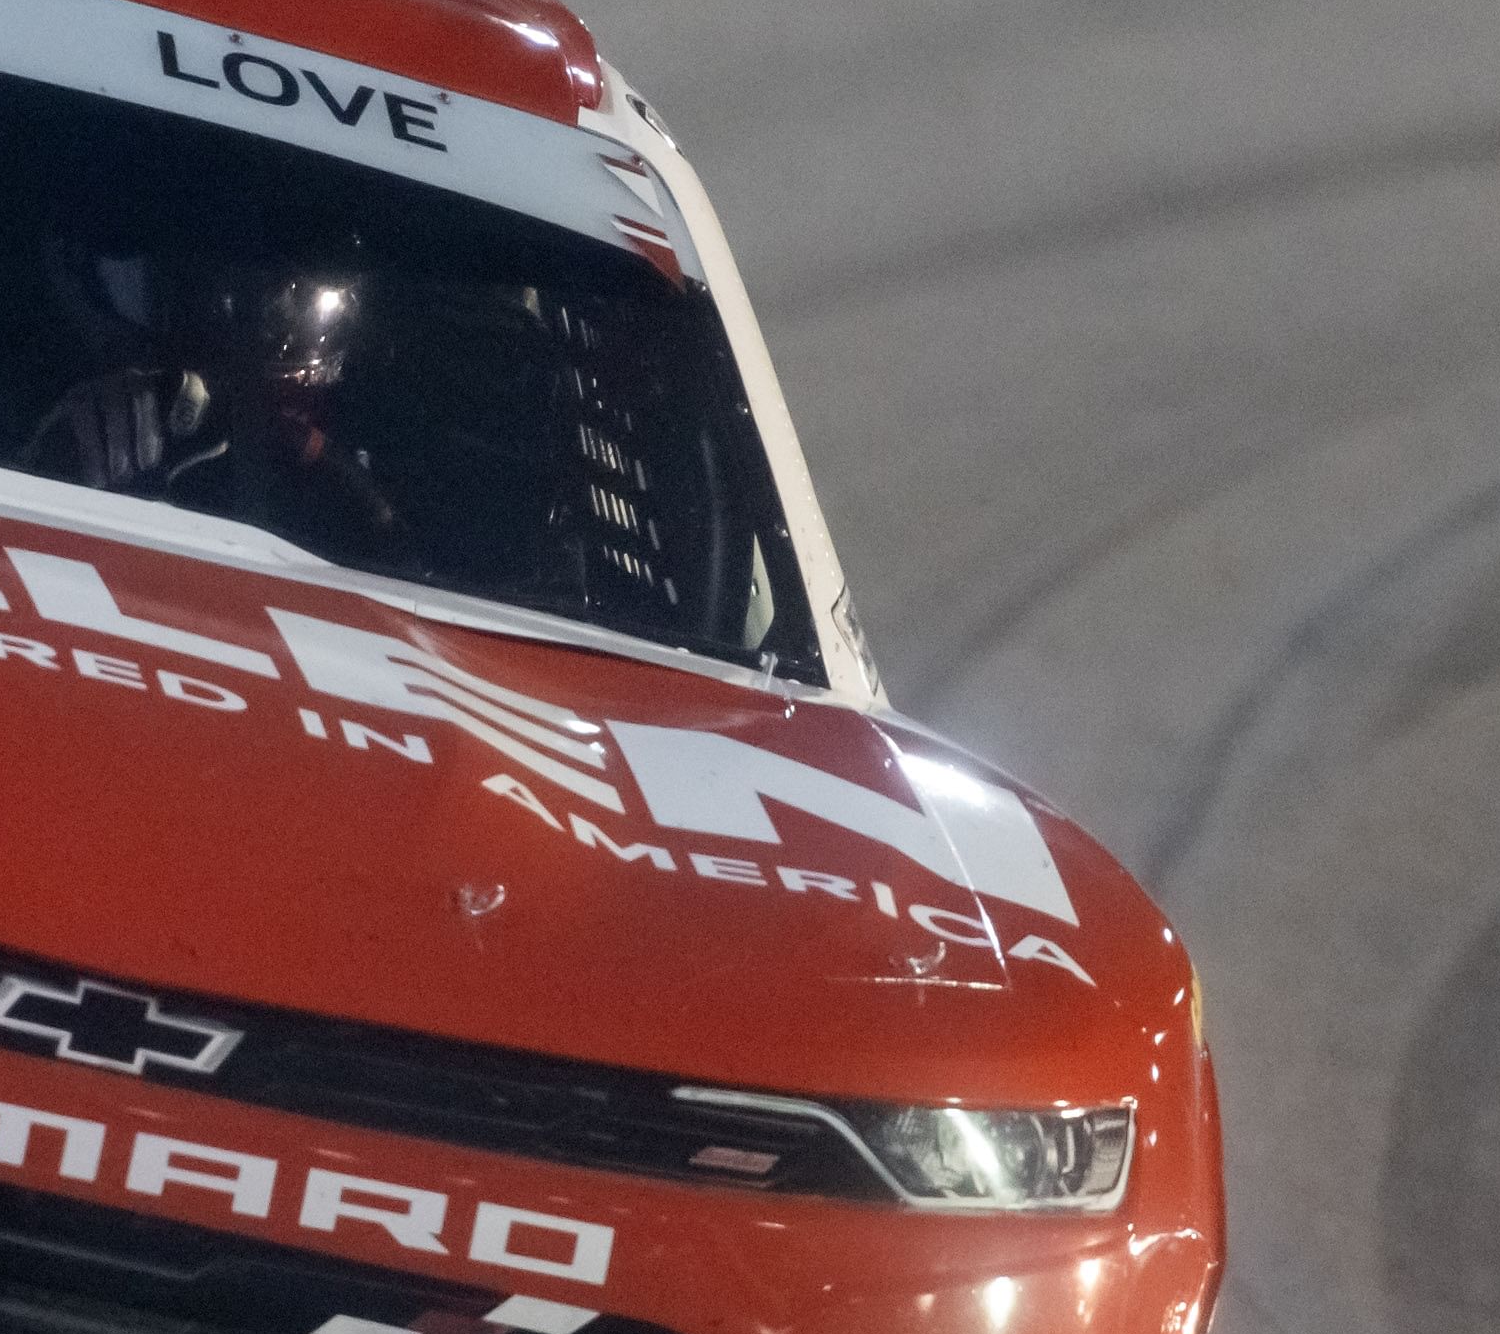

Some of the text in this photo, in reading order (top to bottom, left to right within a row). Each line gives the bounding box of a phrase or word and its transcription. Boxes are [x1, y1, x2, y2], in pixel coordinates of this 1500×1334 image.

[156, 30, 448, 153] LOVE
[298, 707, 435, 765] IN
[480, 772, 1097, 988] AMERICA
